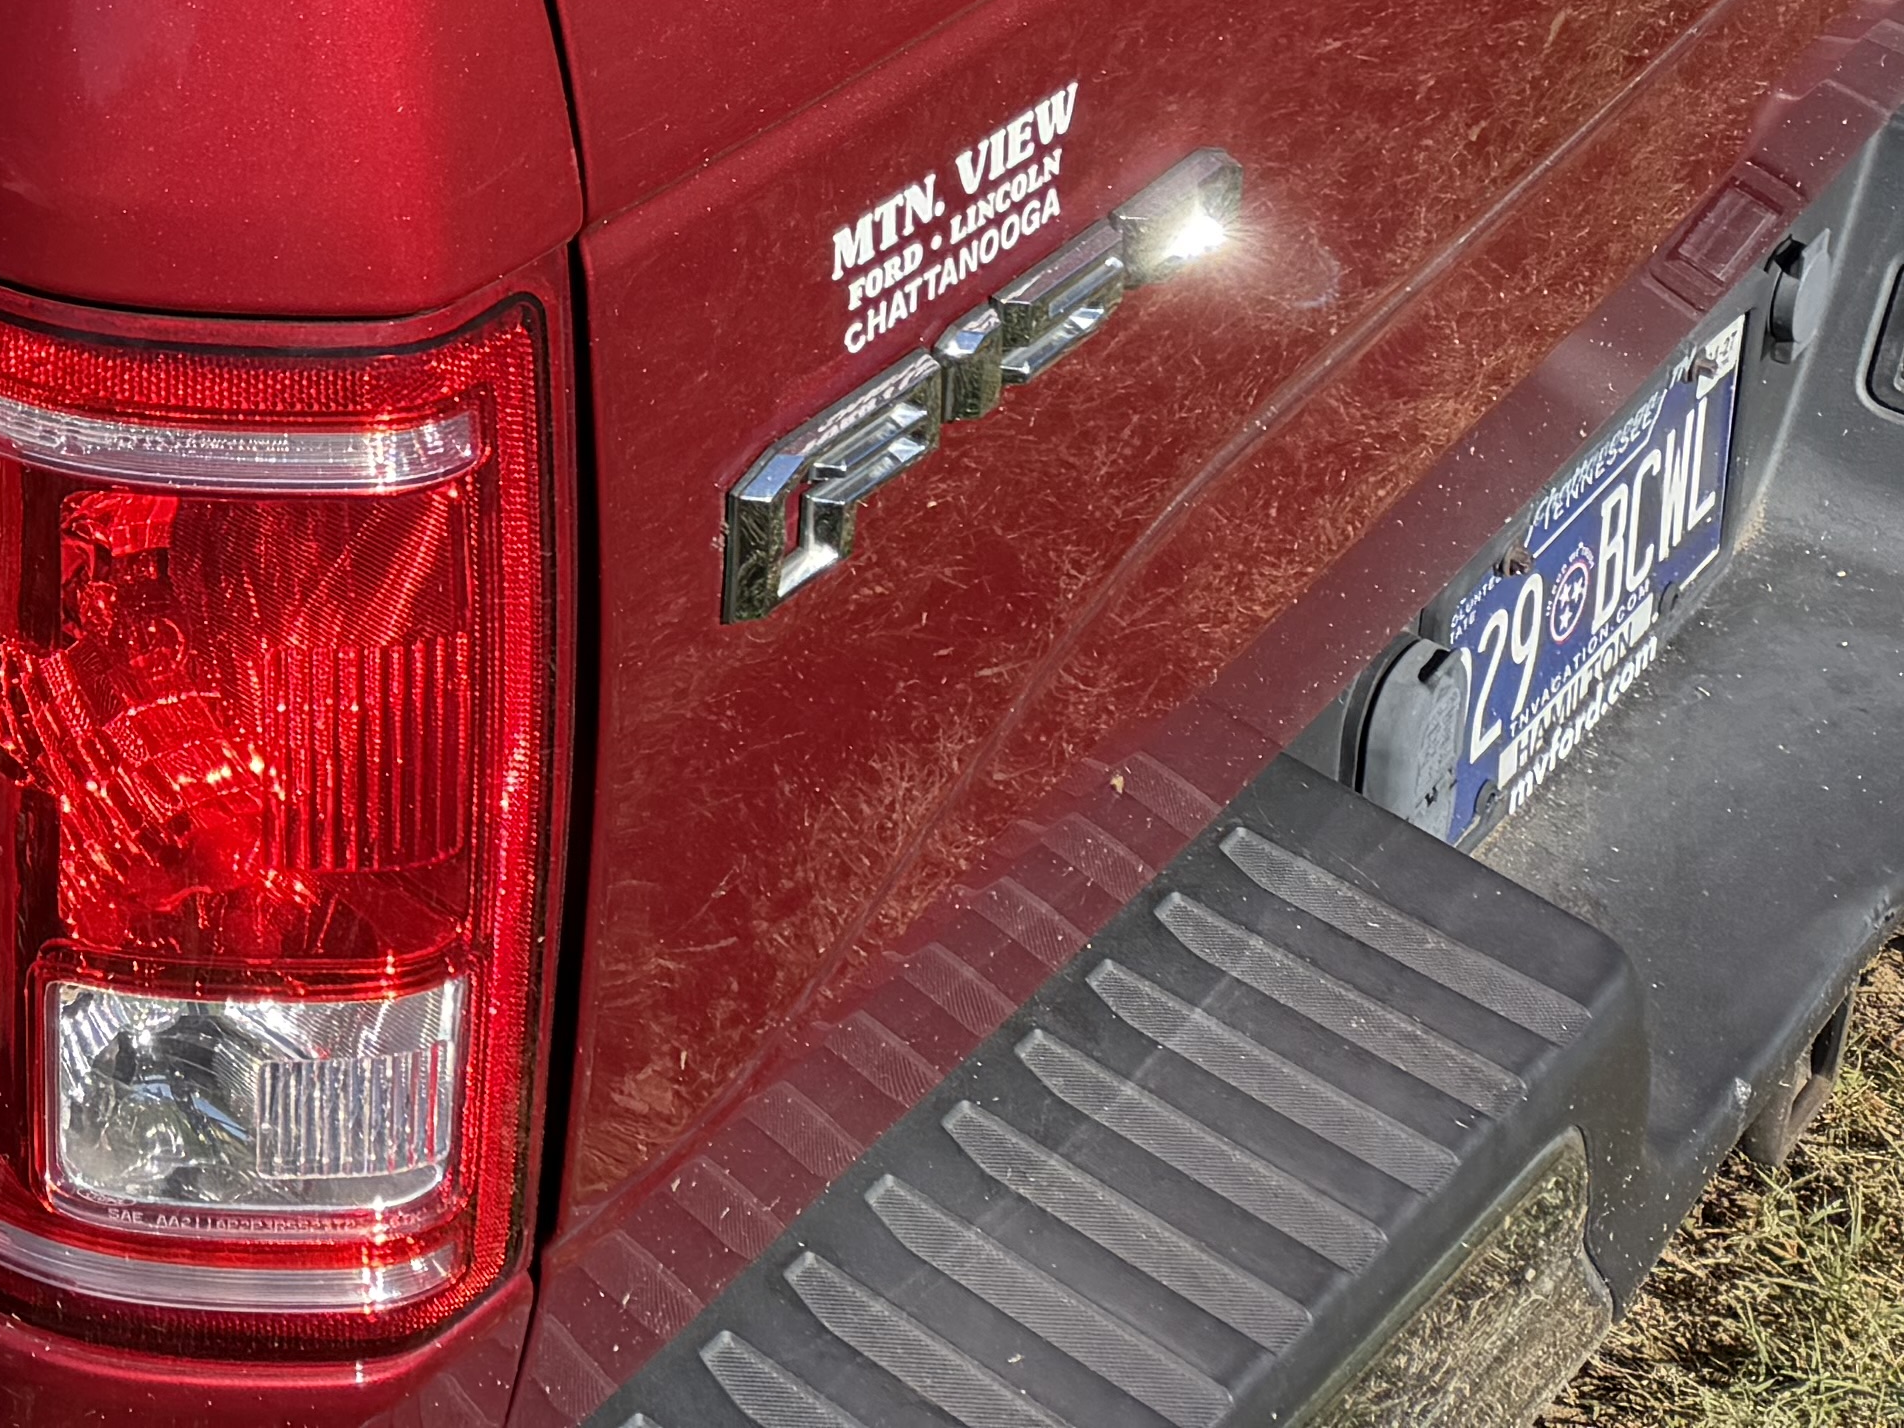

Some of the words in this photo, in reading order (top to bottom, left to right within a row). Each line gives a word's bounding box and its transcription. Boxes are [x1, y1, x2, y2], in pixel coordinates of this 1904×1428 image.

[830, 173, 945, 280] MTN.
[955, 81, 1079, 195] VIEW
[847, 248, 924, 311] FORD
[950, 148, 1062, 243] LINCOLN
[843, 188, 1062, 353] CHATTANOOGA
[1460, 573, 1544, 765] 29
[1592, 396, 1716, 635] BCWL
[1510, 578, 1650, 738] TNVACATION.COM
[1509, 635, 1658, 815] mvford.com
[108, 1207, 144, 1224] SAE
